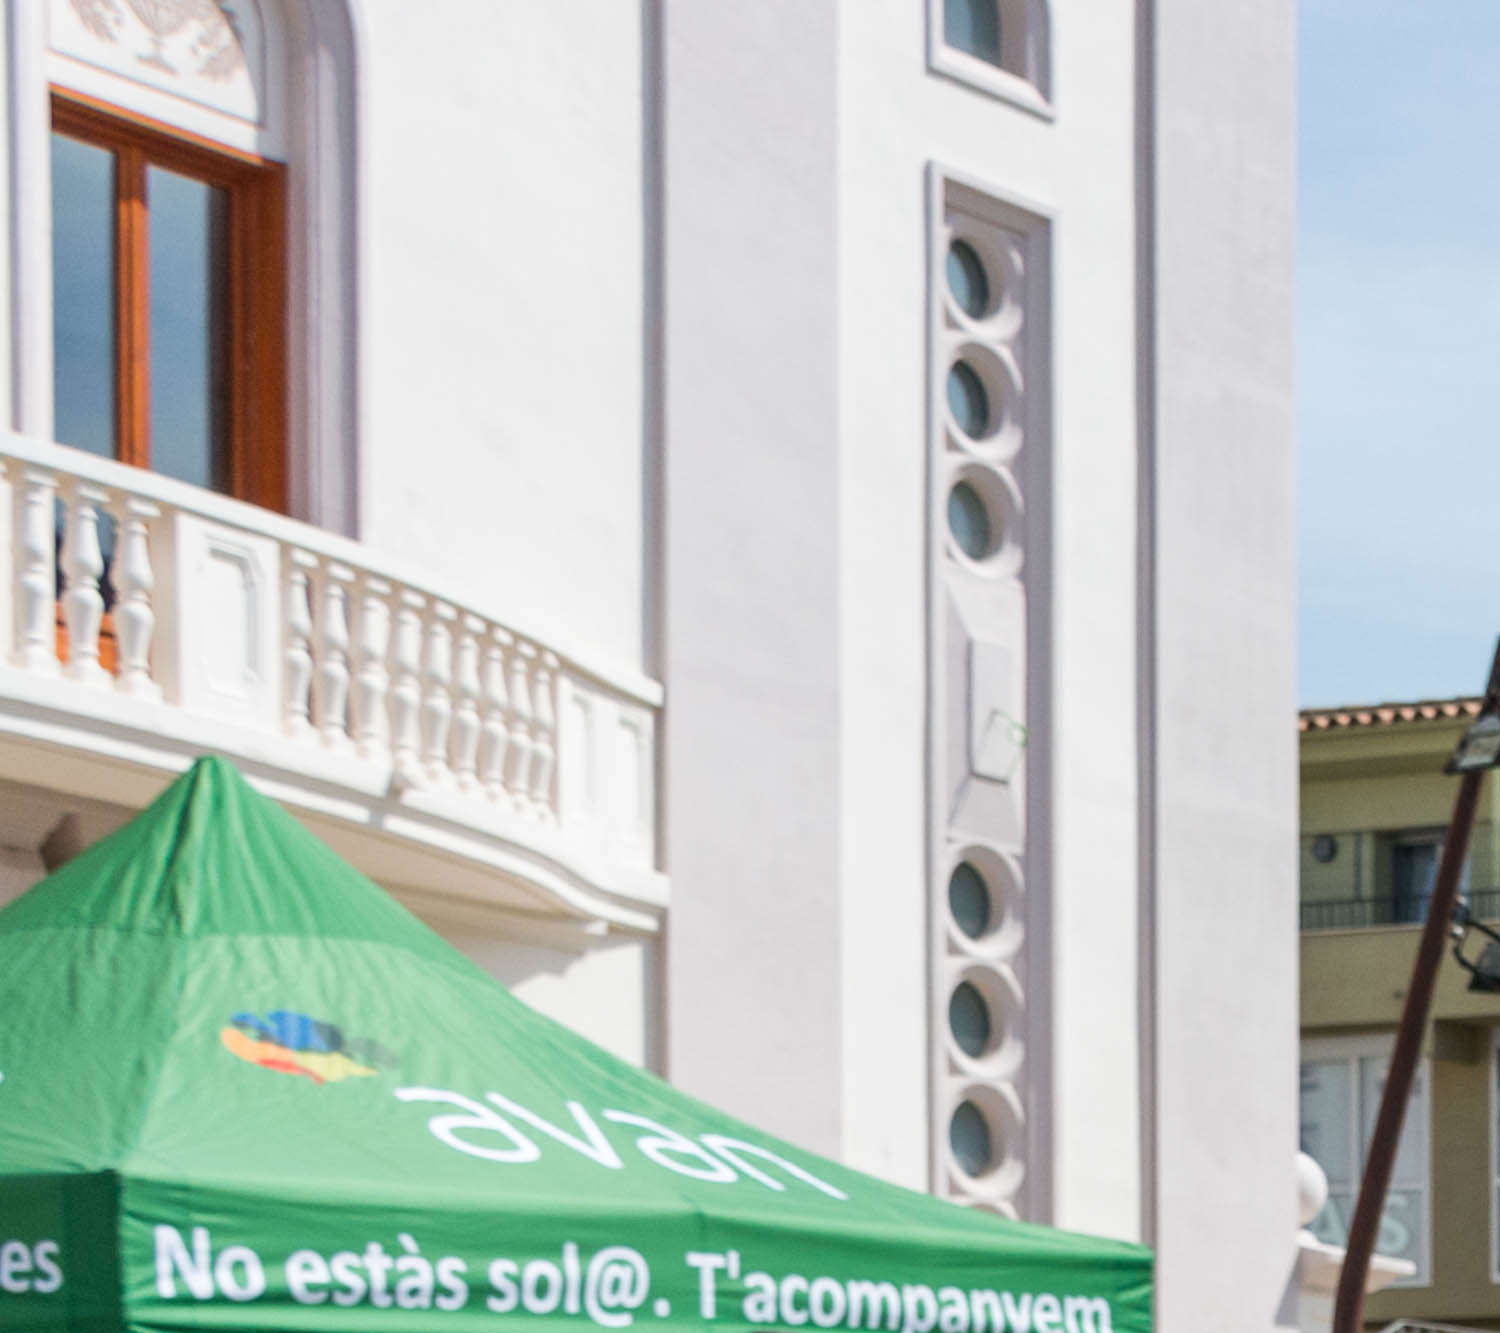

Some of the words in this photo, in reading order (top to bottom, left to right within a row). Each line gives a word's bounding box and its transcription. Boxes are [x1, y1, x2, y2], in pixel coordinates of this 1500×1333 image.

[394, 1086, 848, 1200] avan
[154, 1224, 267, 1300] No
[285, 1232, 470, 1312] estàs
[486, 1240, 672, 1329] sol@.
